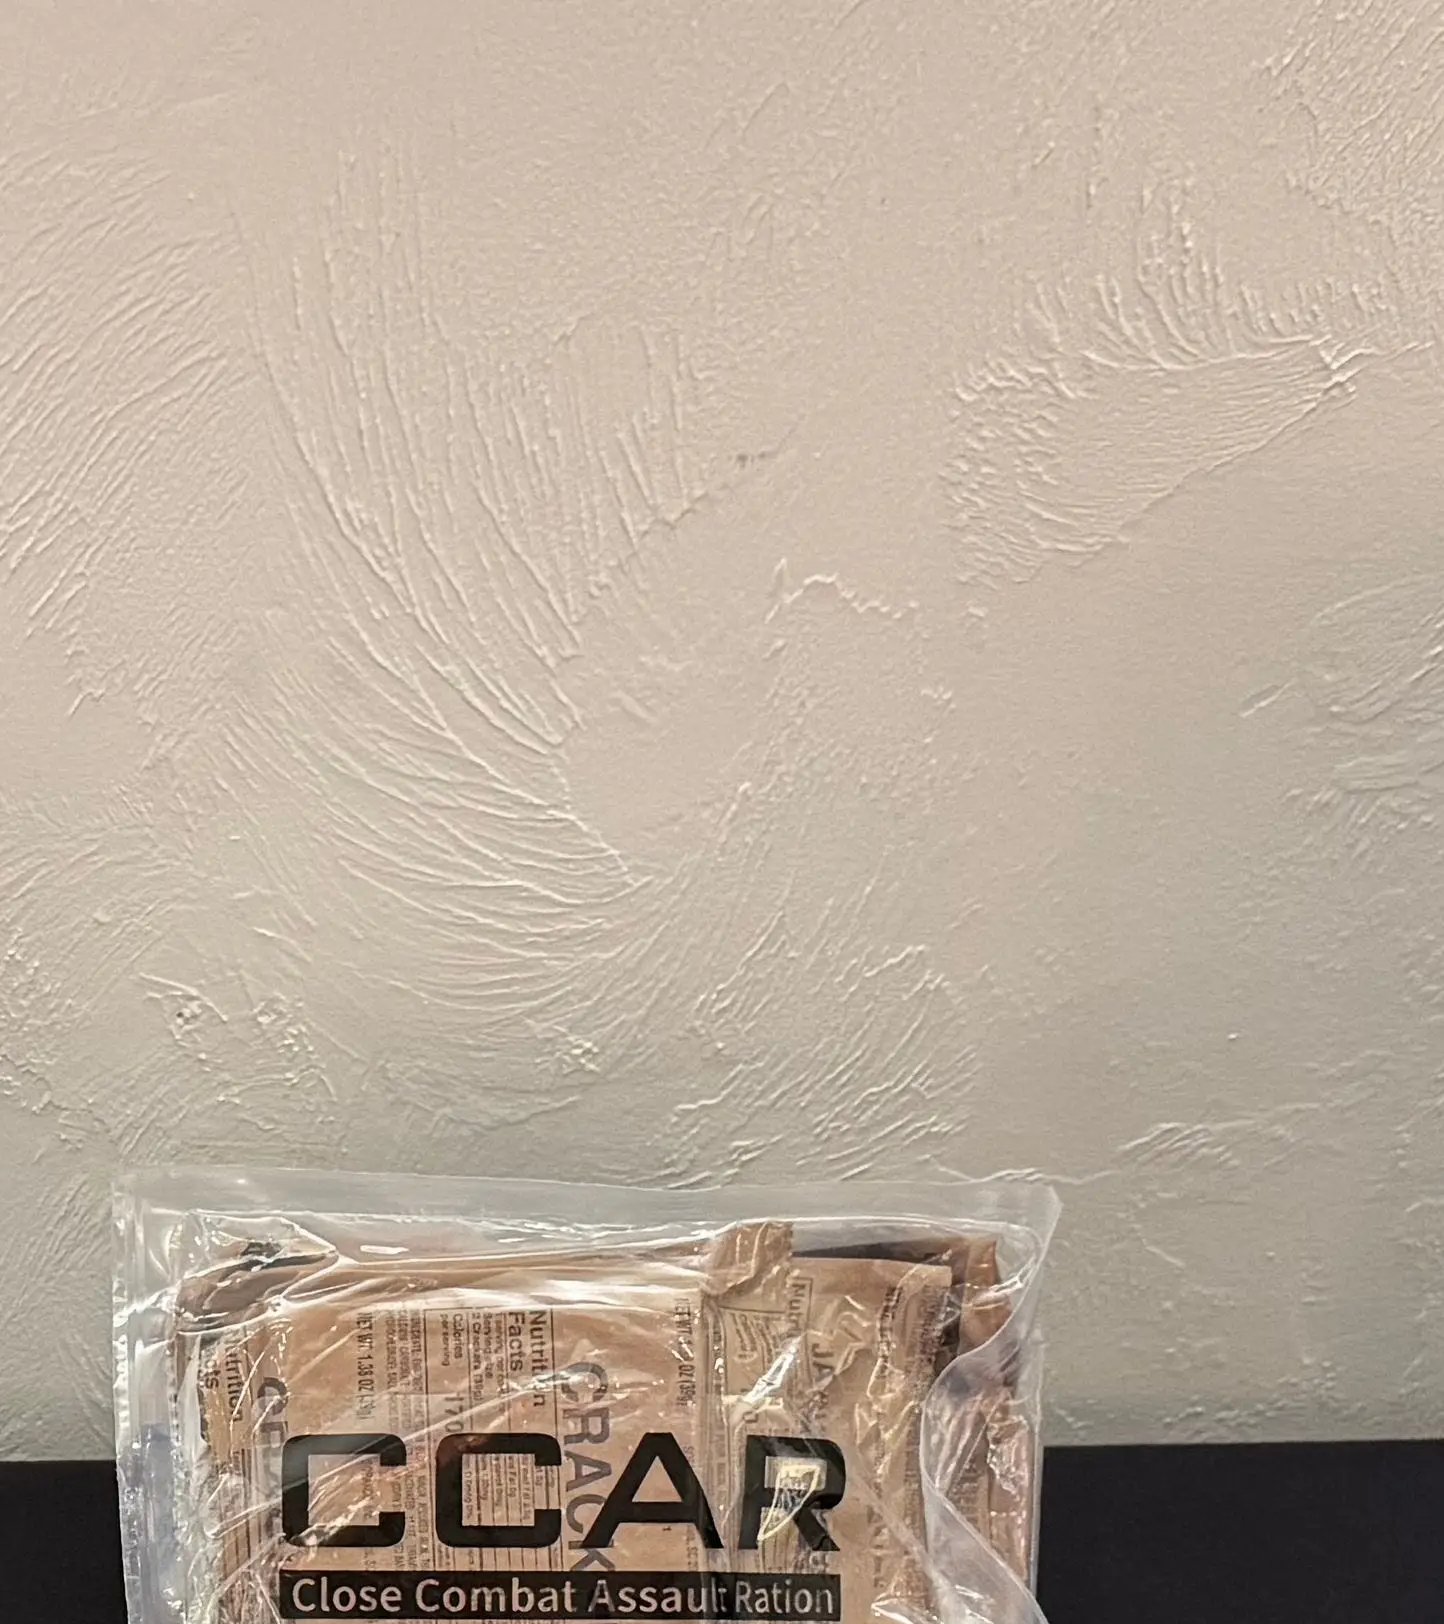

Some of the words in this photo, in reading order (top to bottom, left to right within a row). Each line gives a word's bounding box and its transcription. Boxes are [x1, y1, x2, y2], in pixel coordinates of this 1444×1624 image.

[281, 1431, 846, 1552] CCAR
[291, 1575, 403, 1615] Close
[414, 1575, 578, 1615] Combat
[587, 1575, 730, 1615] Assault
[735, 1577, 834, 1617] Ration
